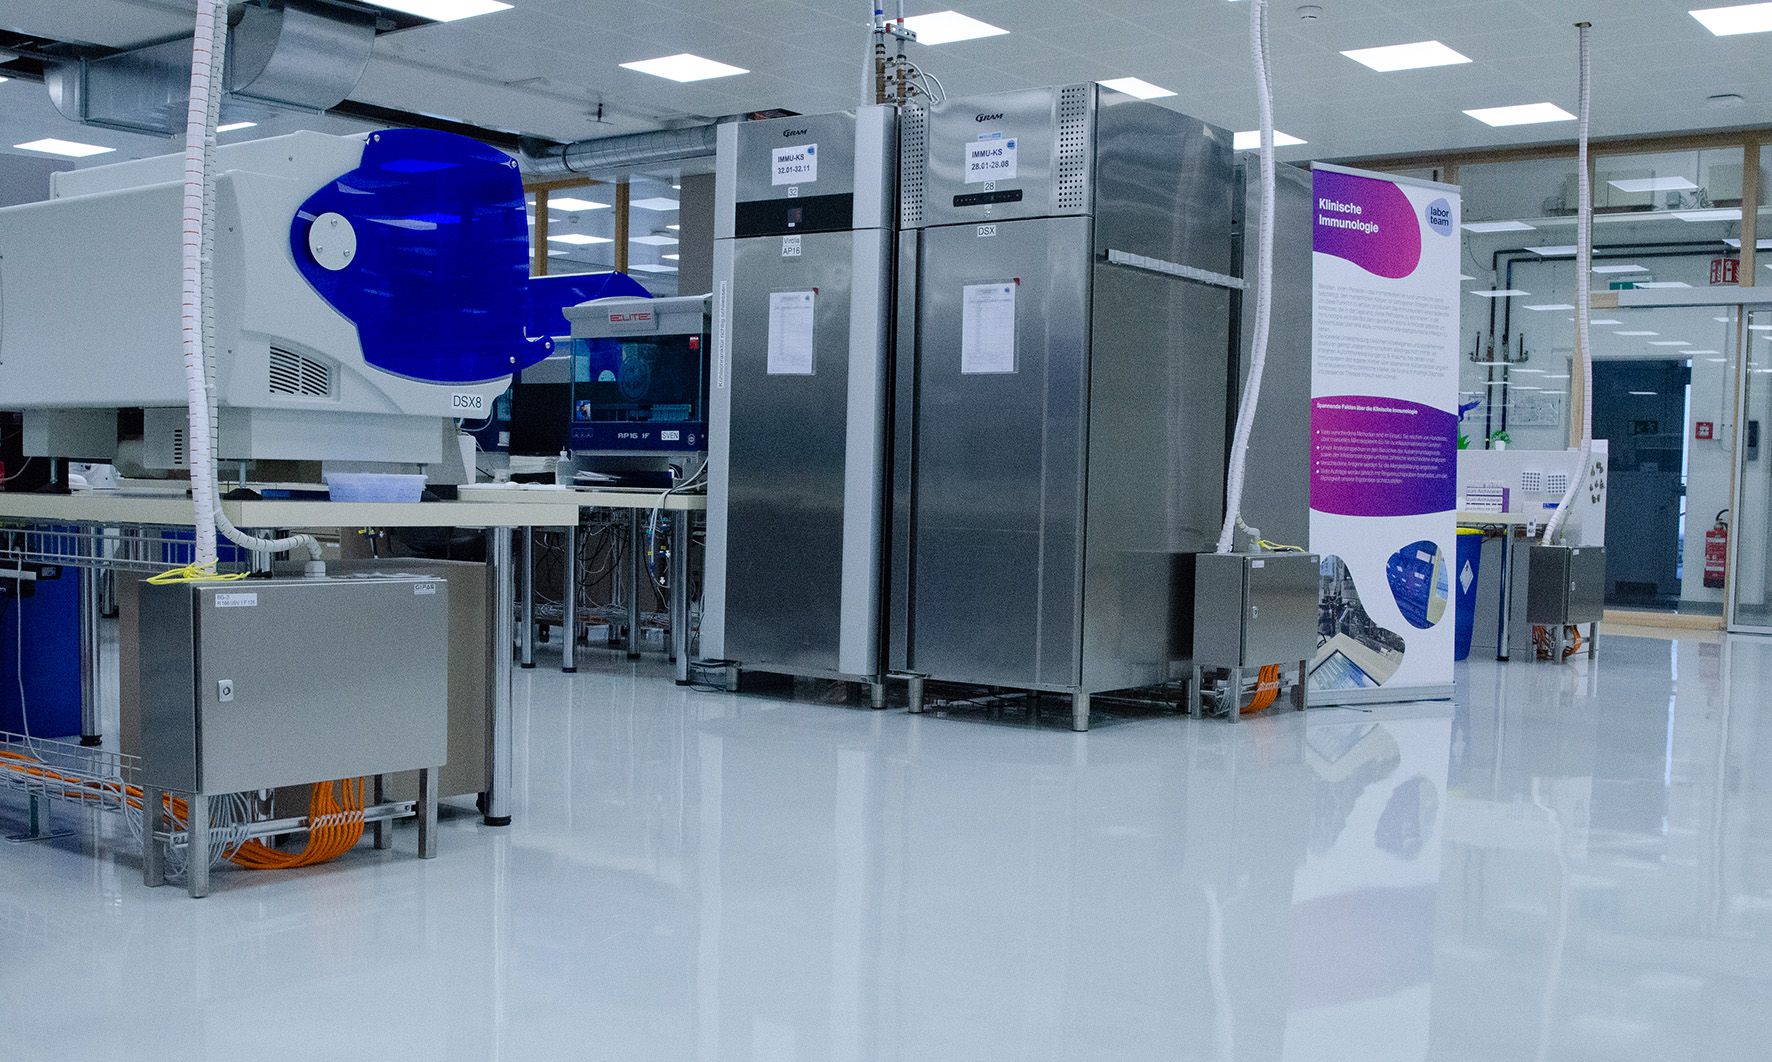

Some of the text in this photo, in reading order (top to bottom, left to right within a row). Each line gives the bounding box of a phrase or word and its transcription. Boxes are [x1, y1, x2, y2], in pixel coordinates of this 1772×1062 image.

[975, 113, 1003, 123] GRAM
[782, 129, 808, 137] GRAM
[777, 153, 805, 163] IMMU-KS
[971, 148, 1003, 158] IMMU-KS
[777, 164, 810, 174] 32.01-32.11
[984, 182, 995, 191] 28
[788, 188, 798, 197] 32
[1319, 197, 1362, 215] Klinische
[1430, 206, 1449, 217] labor
[1319, 213, 1379, 234] Immunologie
[1430, 216, 1449, 227] team
[978, 226, 996, 236] DSX
[783, 246, 801, 255] AP16
[453, 395, 482, 409] DSX8
[662, 431, 679, 440] SVEN
